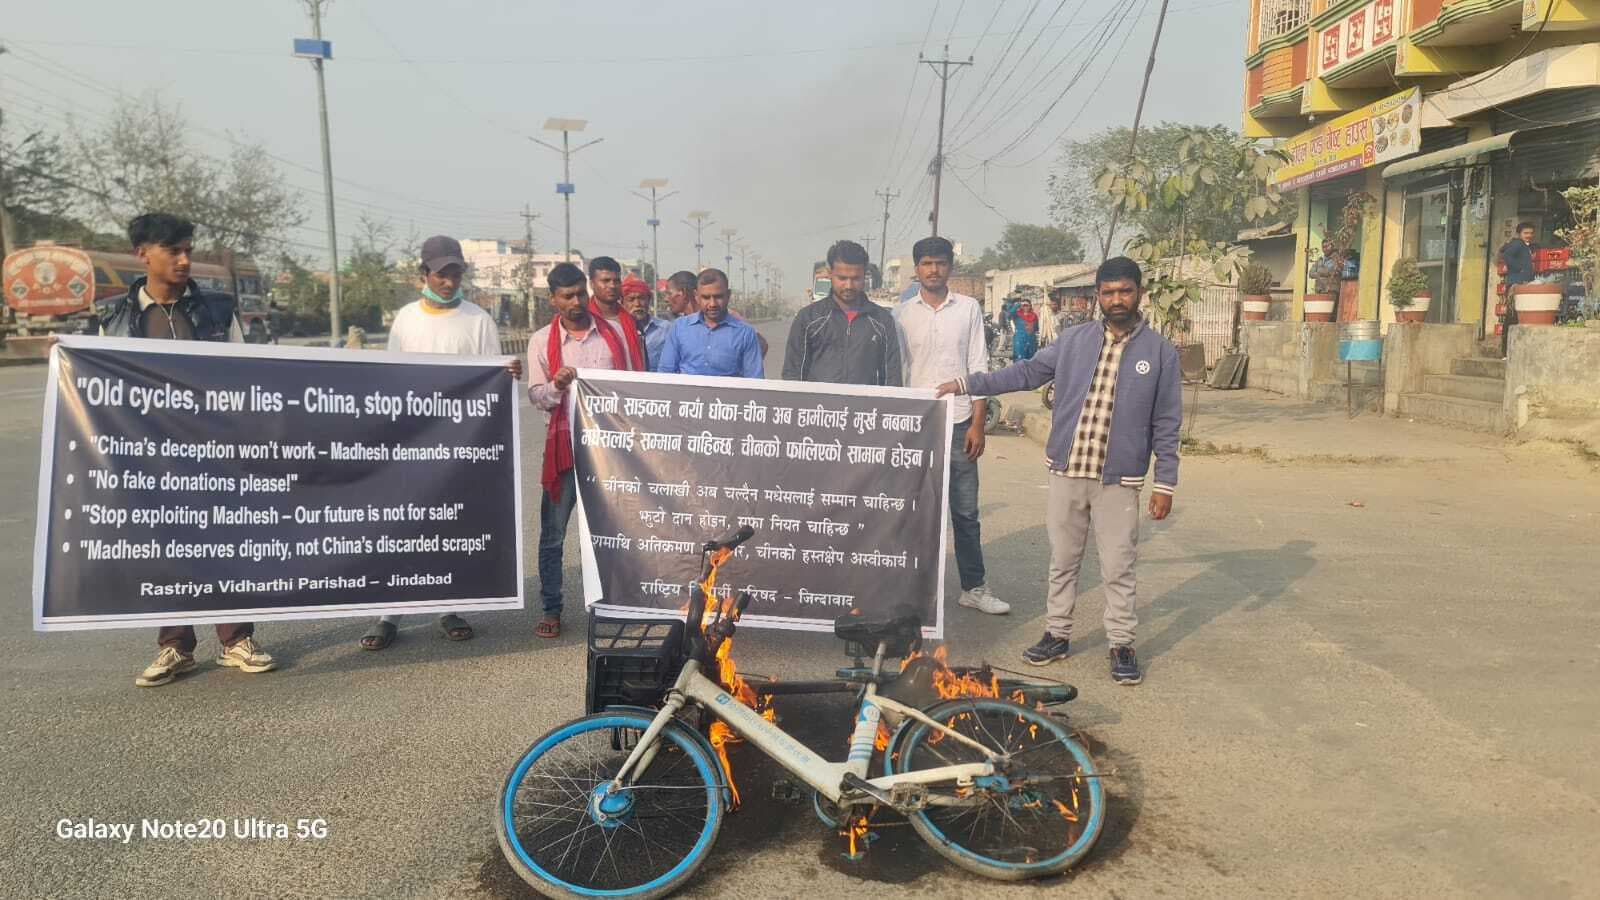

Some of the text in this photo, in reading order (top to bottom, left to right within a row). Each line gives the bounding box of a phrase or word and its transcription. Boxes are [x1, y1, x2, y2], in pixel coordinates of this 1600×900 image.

[77, 377, 123, 408] "Old
[129, 382, 199, 414] cycles,
[206, 390, 244, 411] new
[251, 384, 283, 412] lies
[304, 388, 359, 418] China,
[365, 393, 402, 421] stop
[407, 390, 462, 422] fooling
[467, 394, 499, 417] us!"
[585, 392, 618, 418] पुरानो
[773, 408, 792, 424] अब
[798, 404, 848, 431] हामीलाई
[854, 408, 877, 434] मुर्ख
[882, 414, 923, 432] नबनाउ
[161, 439, 235, 463] deception
[282, 442, 316, 460] work
[331, 442, 389, 461] Madhesh
[393, 442, 450, 460] demands
[454, 443, 504, 463] respect!"
[640, 432, 682, 452] सम्मान
[741, 433, 780, 458] चीनको
[786, 437, 841, 461] फालिएको
[847, 446, 886, 464] सामान
[891, 443, 923, 469] होइन
[89, 471, 298, 496] "No fake donations please!"
[602, 477, 641, 494] चीनको
[648, 480, 690, 496] चलाखी
[696, 485, 718, 499] अब
[724, 482, 758, 502] चल्दैन
[820, 493, 857, 508] सम्मान
[863, 493, 905, 511] चाहिन्छ
[82, 506, 127, 527] "Stop
[132, 506, 208, 528] exploiting
[213, 506, 278, 524] Madhesh
[295, 506, 320, 523] Our
[324, 506, 364, 523] future
[368, 506, 379, 522] is
[383, 505, 403, 521] not
[408, 504, 425, 521] for
[429, 503, 464, 521] sale!"
[672, 512, 693, 526] दान
[770, 515, 800, 532] नियत
[806, 518, 850, 536] चाहिन्छ
[80, 540, 160, 561] "Madhesh
[165, 539, 235, 559] deserves
[239, 538, 291, 562] dignity,
[295, 539, 319, 556] not
[377, 535, 439, 554] discarded
[442, 534, 491, 555] scraps!"
[591, 533, 631, 550] शमाथि
[638, 537, 695, 554] अतिक्रमण
[756, 542, 796, 560] चीनको
[801, 546, 844, 566] हस्तक्षेप
[141, 582, 213, 597] Rastriya
[218, 578, 293, 593] Vidharthi
[298, 576, 365, 590] Parishad
[387, 573, 452, 588] Jindabad
[738, 585, 778, 602] रिषद
